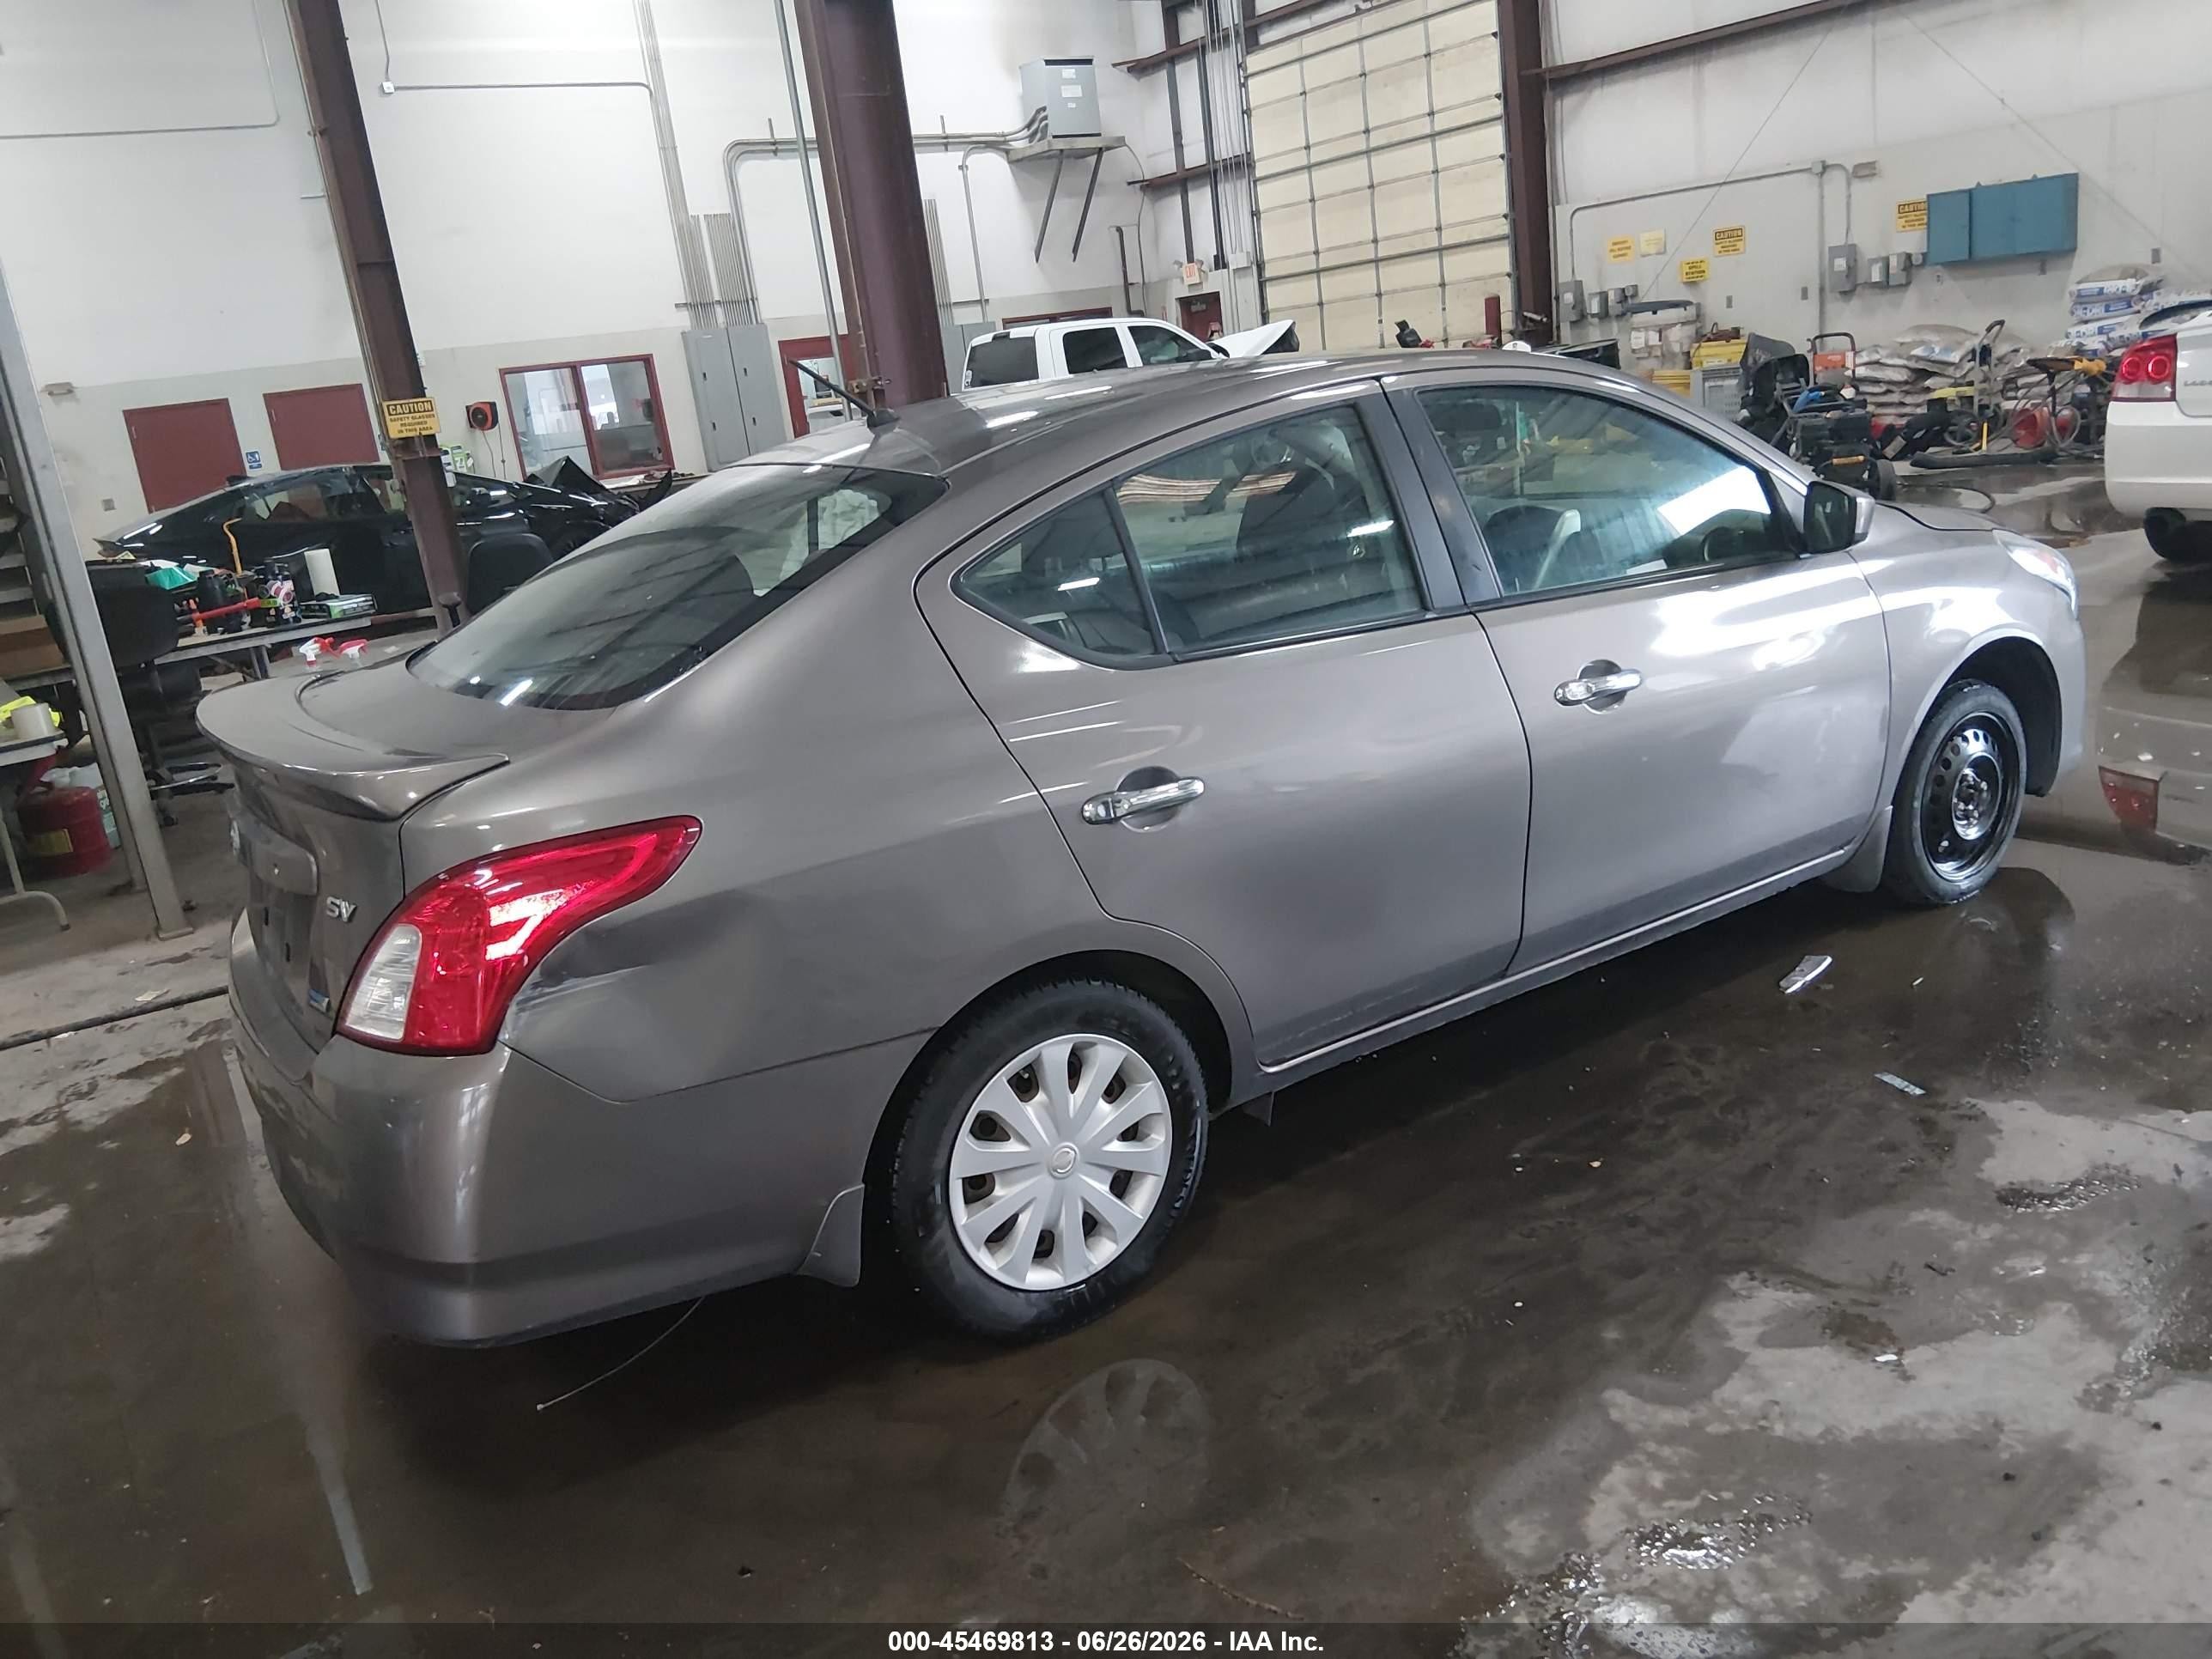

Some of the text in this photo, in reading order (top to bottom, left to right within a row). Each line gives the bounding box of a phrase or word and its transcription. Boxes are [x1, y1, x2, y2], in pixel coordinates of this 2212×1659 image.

[1899, 202, 1926, 213] CAUTIO
[389, 401, 432, 415] CAUTION
[326, 896, 357, 922] SV
